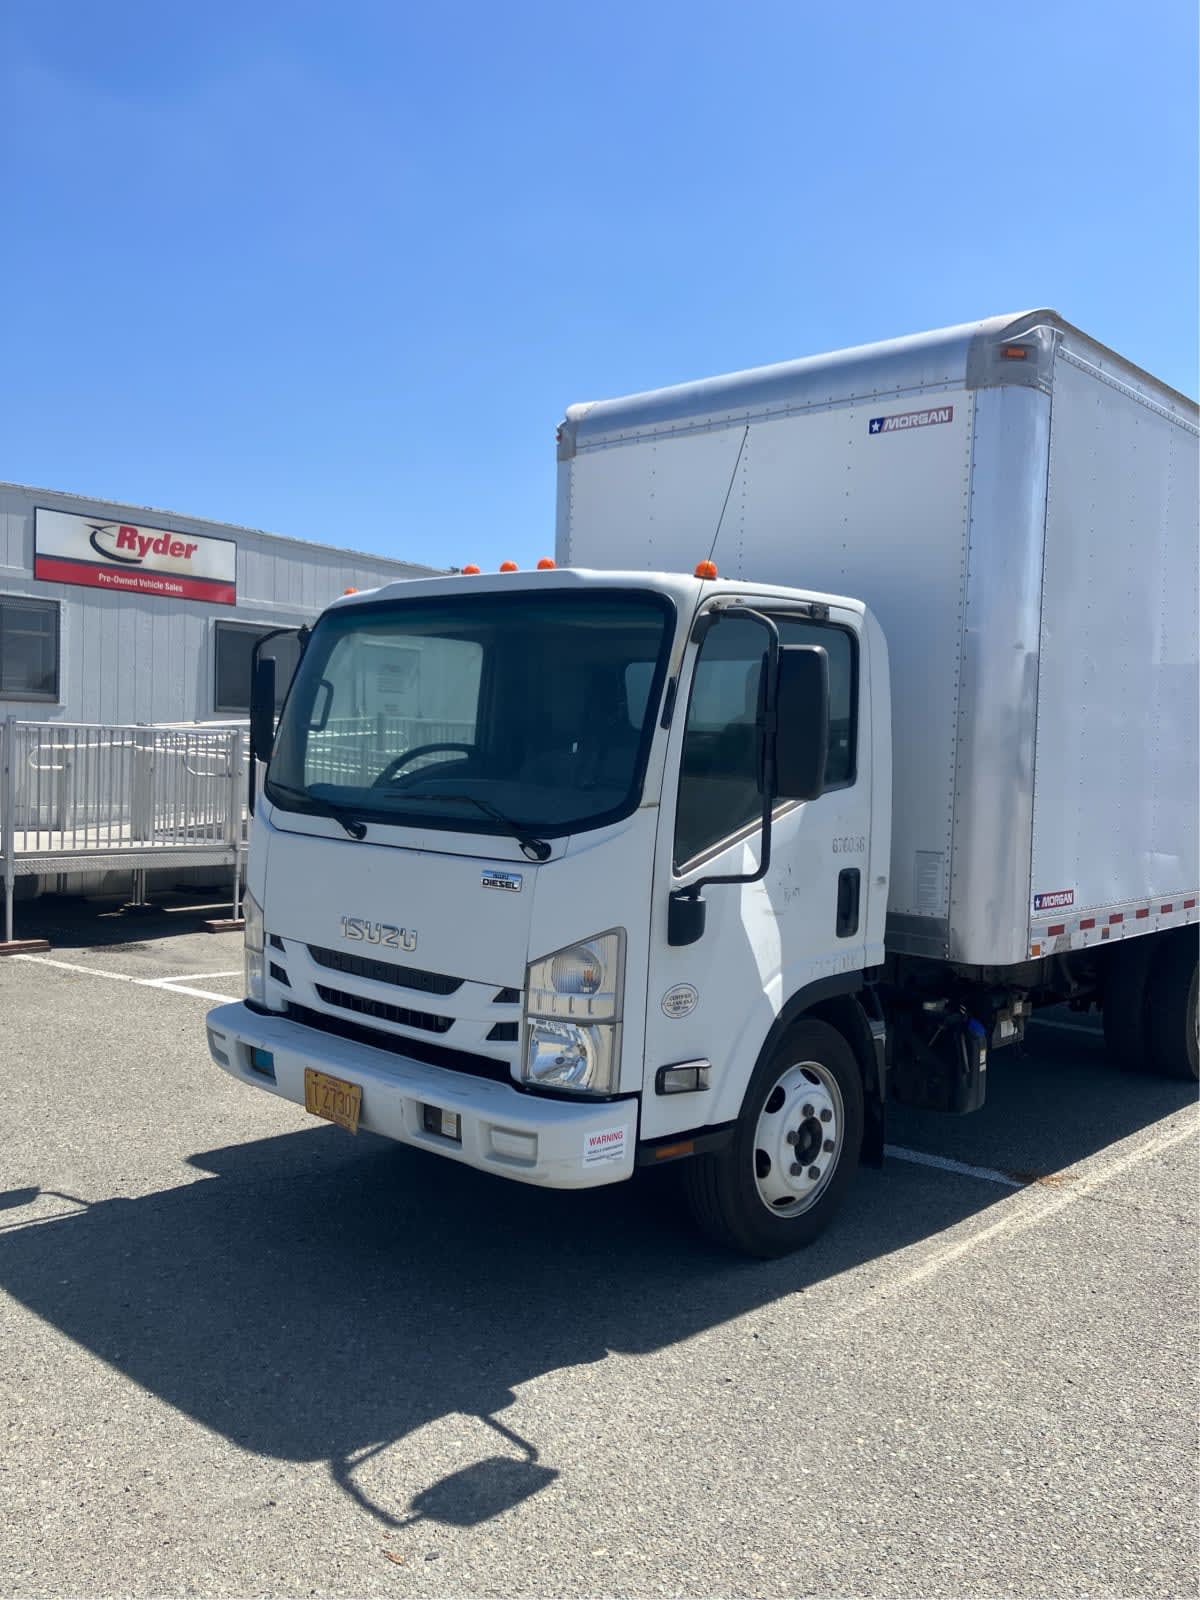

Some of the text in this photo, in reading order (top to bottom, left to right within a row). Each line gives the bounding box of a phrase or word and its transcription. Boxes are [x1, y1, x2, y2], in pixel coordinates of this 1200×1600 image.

[884, 409, 949, 431] MORGAN
[116, 525, 198, 559] Ryder
[99, 573, 183, 593] Pre-Owned Vehicle Sales
[482, 878, 518, 890] DIESEL
[1041, 892, 1073, 908] MORGAN
[341, 914, 418, 952] ISUZU
[589, 1130, 623, 1146] WARNING
